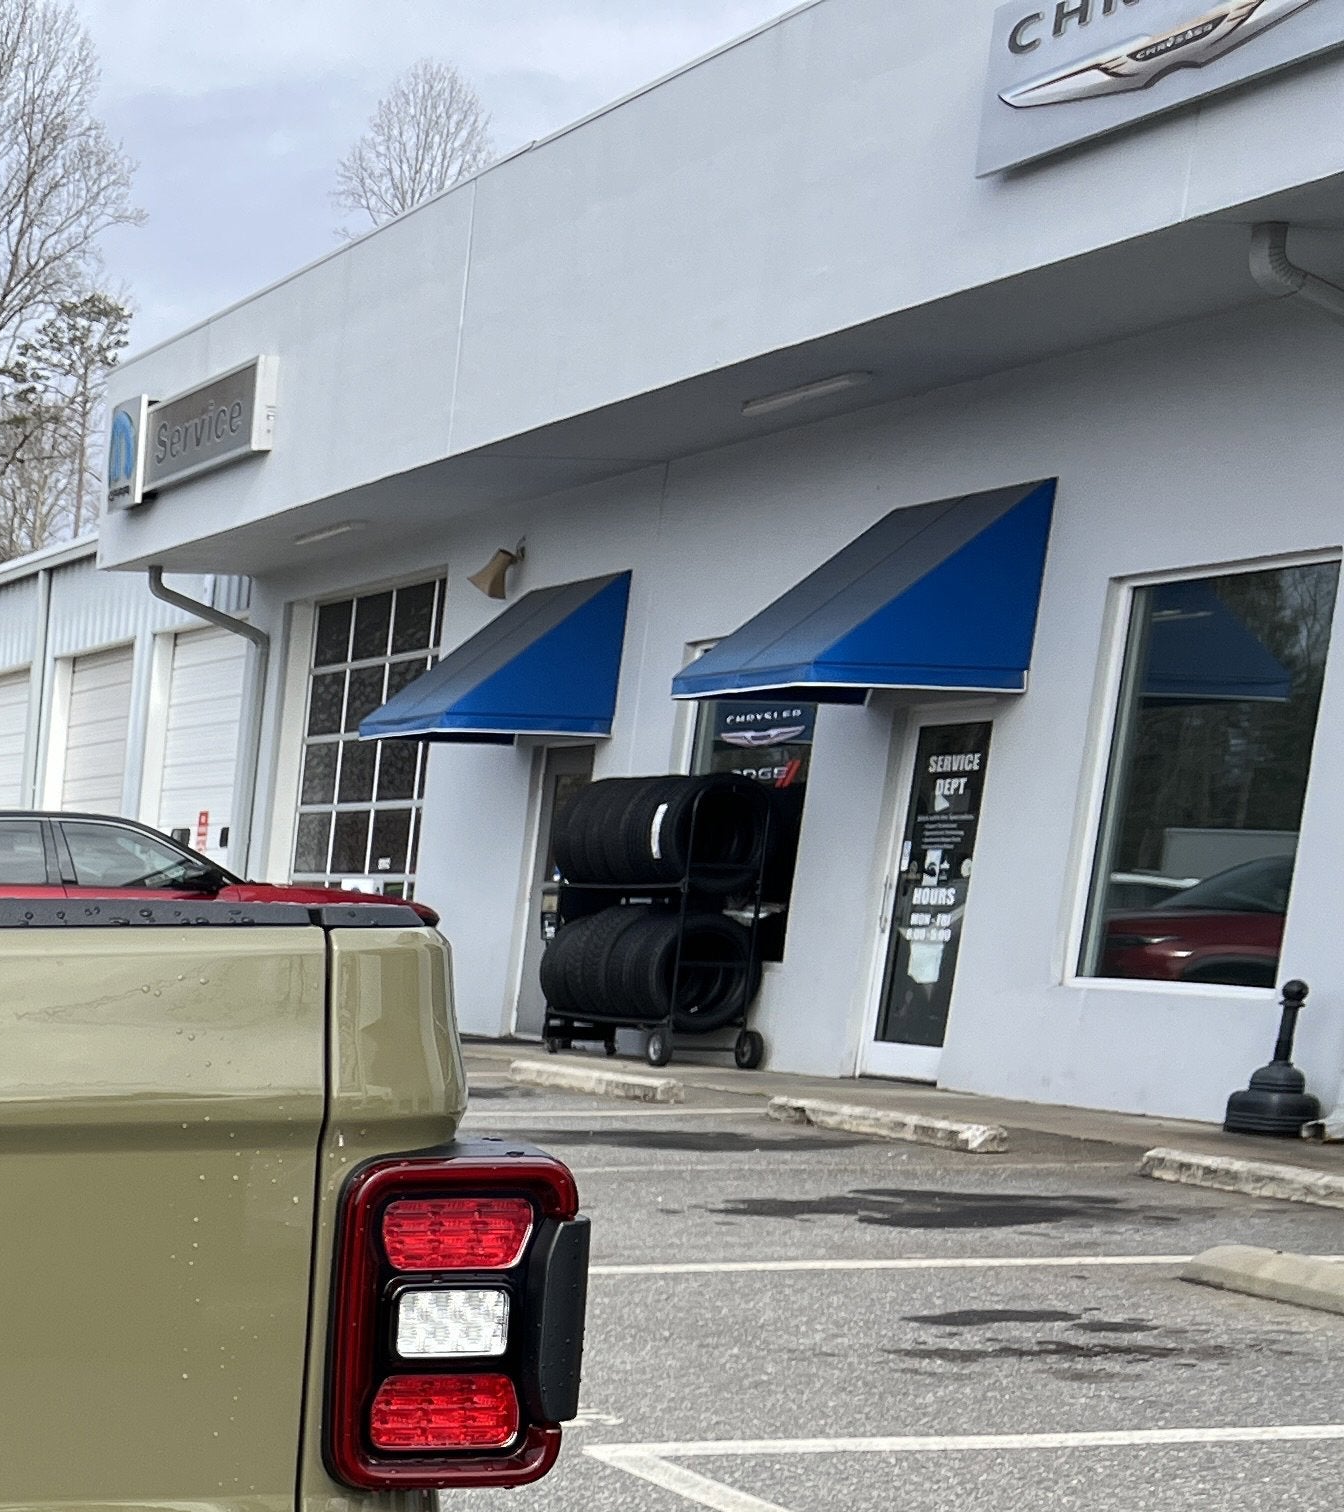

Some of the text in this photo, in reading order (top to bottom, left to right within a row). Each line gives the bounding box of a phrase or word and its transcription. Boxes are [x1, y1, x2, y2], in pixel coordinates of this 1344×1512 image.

[155, 399, 243, 465] Service
[928, 753, 981, 773] SERVICE
[934, 777, 968, 796] DEPT
[912, 887, 956, 905] HOURS
